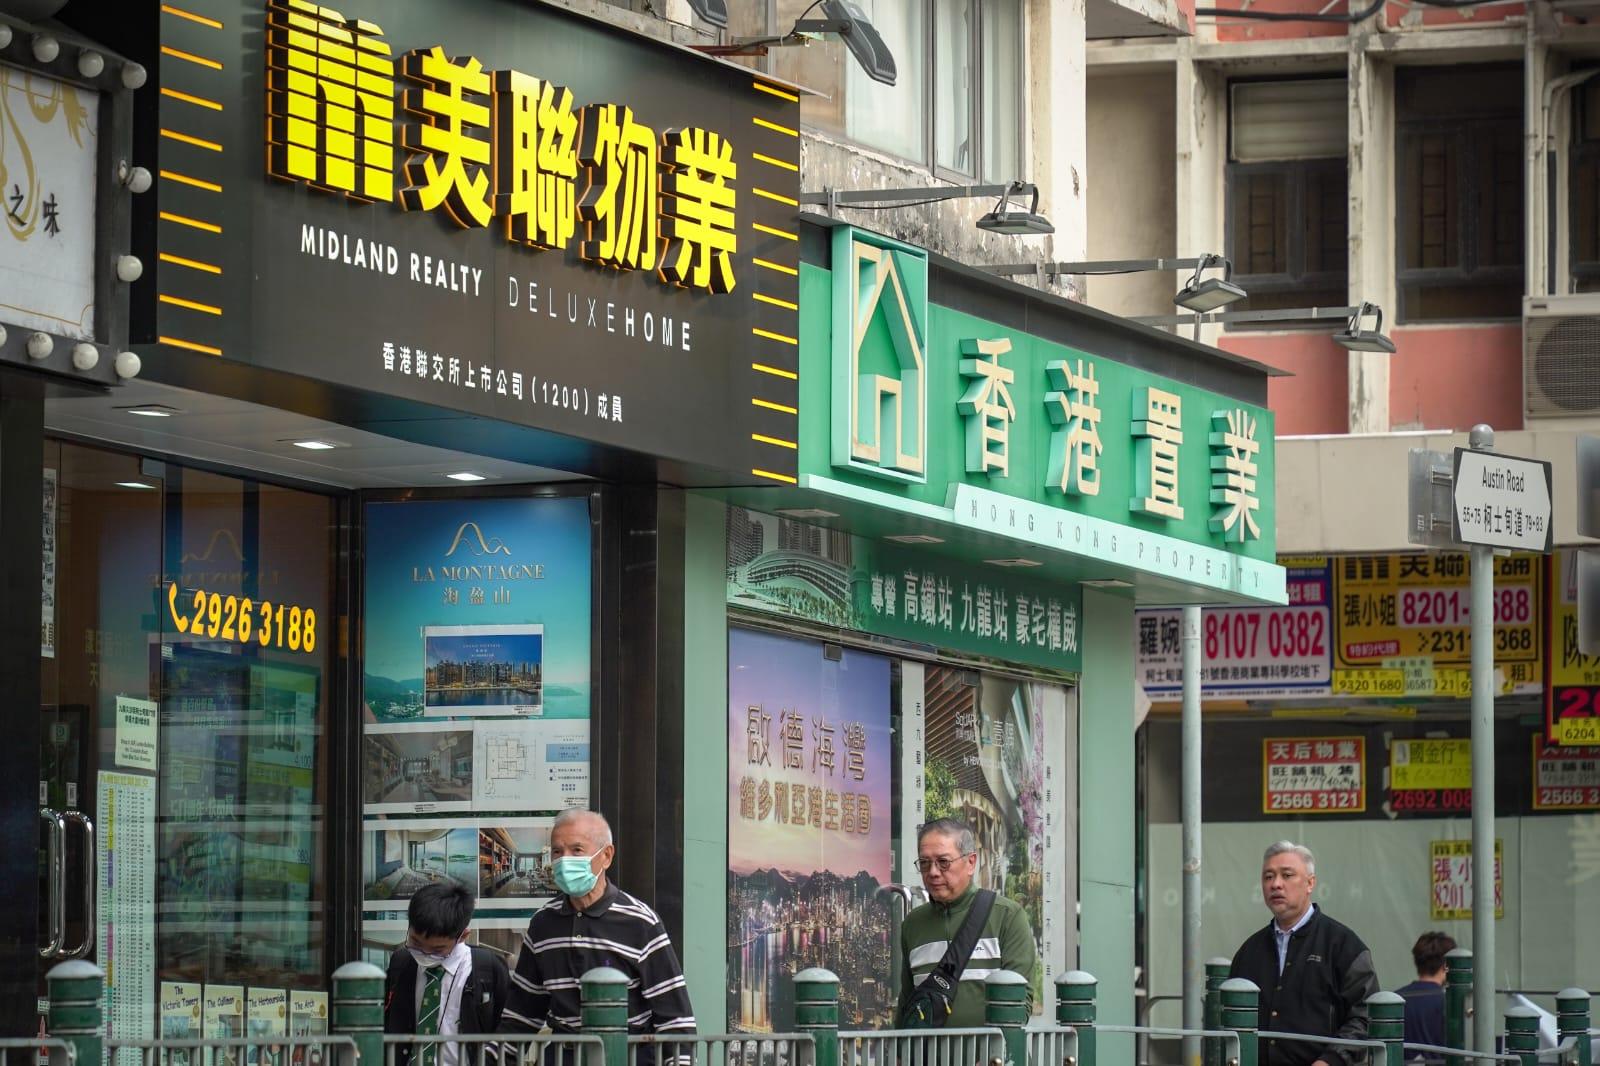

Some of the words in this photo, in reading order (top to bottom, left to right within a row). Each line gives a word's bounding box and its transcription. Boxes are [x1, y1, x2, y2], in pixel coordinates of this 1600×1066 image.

[407, 47, 737, 294] 美聯物業
[301, 224, 399, 275] MIDLAND
[410, 252, 482, 296] REALTY
[958, 337, 1262, 543] 香港置業
[1482, 466, 1504, 490] Austin
[1507, 469, 1525, 492] Road
[1483, 503, 1523, 537] 柯士甸道
[971, 499, 1034, 532] HONG
[1057, 520, 1117, 553] KONG
[1138, 542, 1262, 588] PROPERTY
[412, 566, 435, 582] LA
[442, 564, 545, 581] MONTAGNE
[190, 590, 252, 643] 2926
[258, 601, 316, 653] 3188
[904, 568, 953, 631] 高鐵站
[960, 581, 1009, 643] 九龍站
[1344, 593, 1397, 628] 張小姐
[1204, 613, 1261, 659] 8107
[1267, 611, 1325, 657] 0382
[1339, 680, 1369, 691] 9320
[1373, 679, 1402, 690] 1680
[1271, 741, 1357, 760] 天后物業
[1271, 793, 1313, 809] 2566
[1318, 792, 1358, 808] 3121
[1541, 789, 1583, 805] 2566
